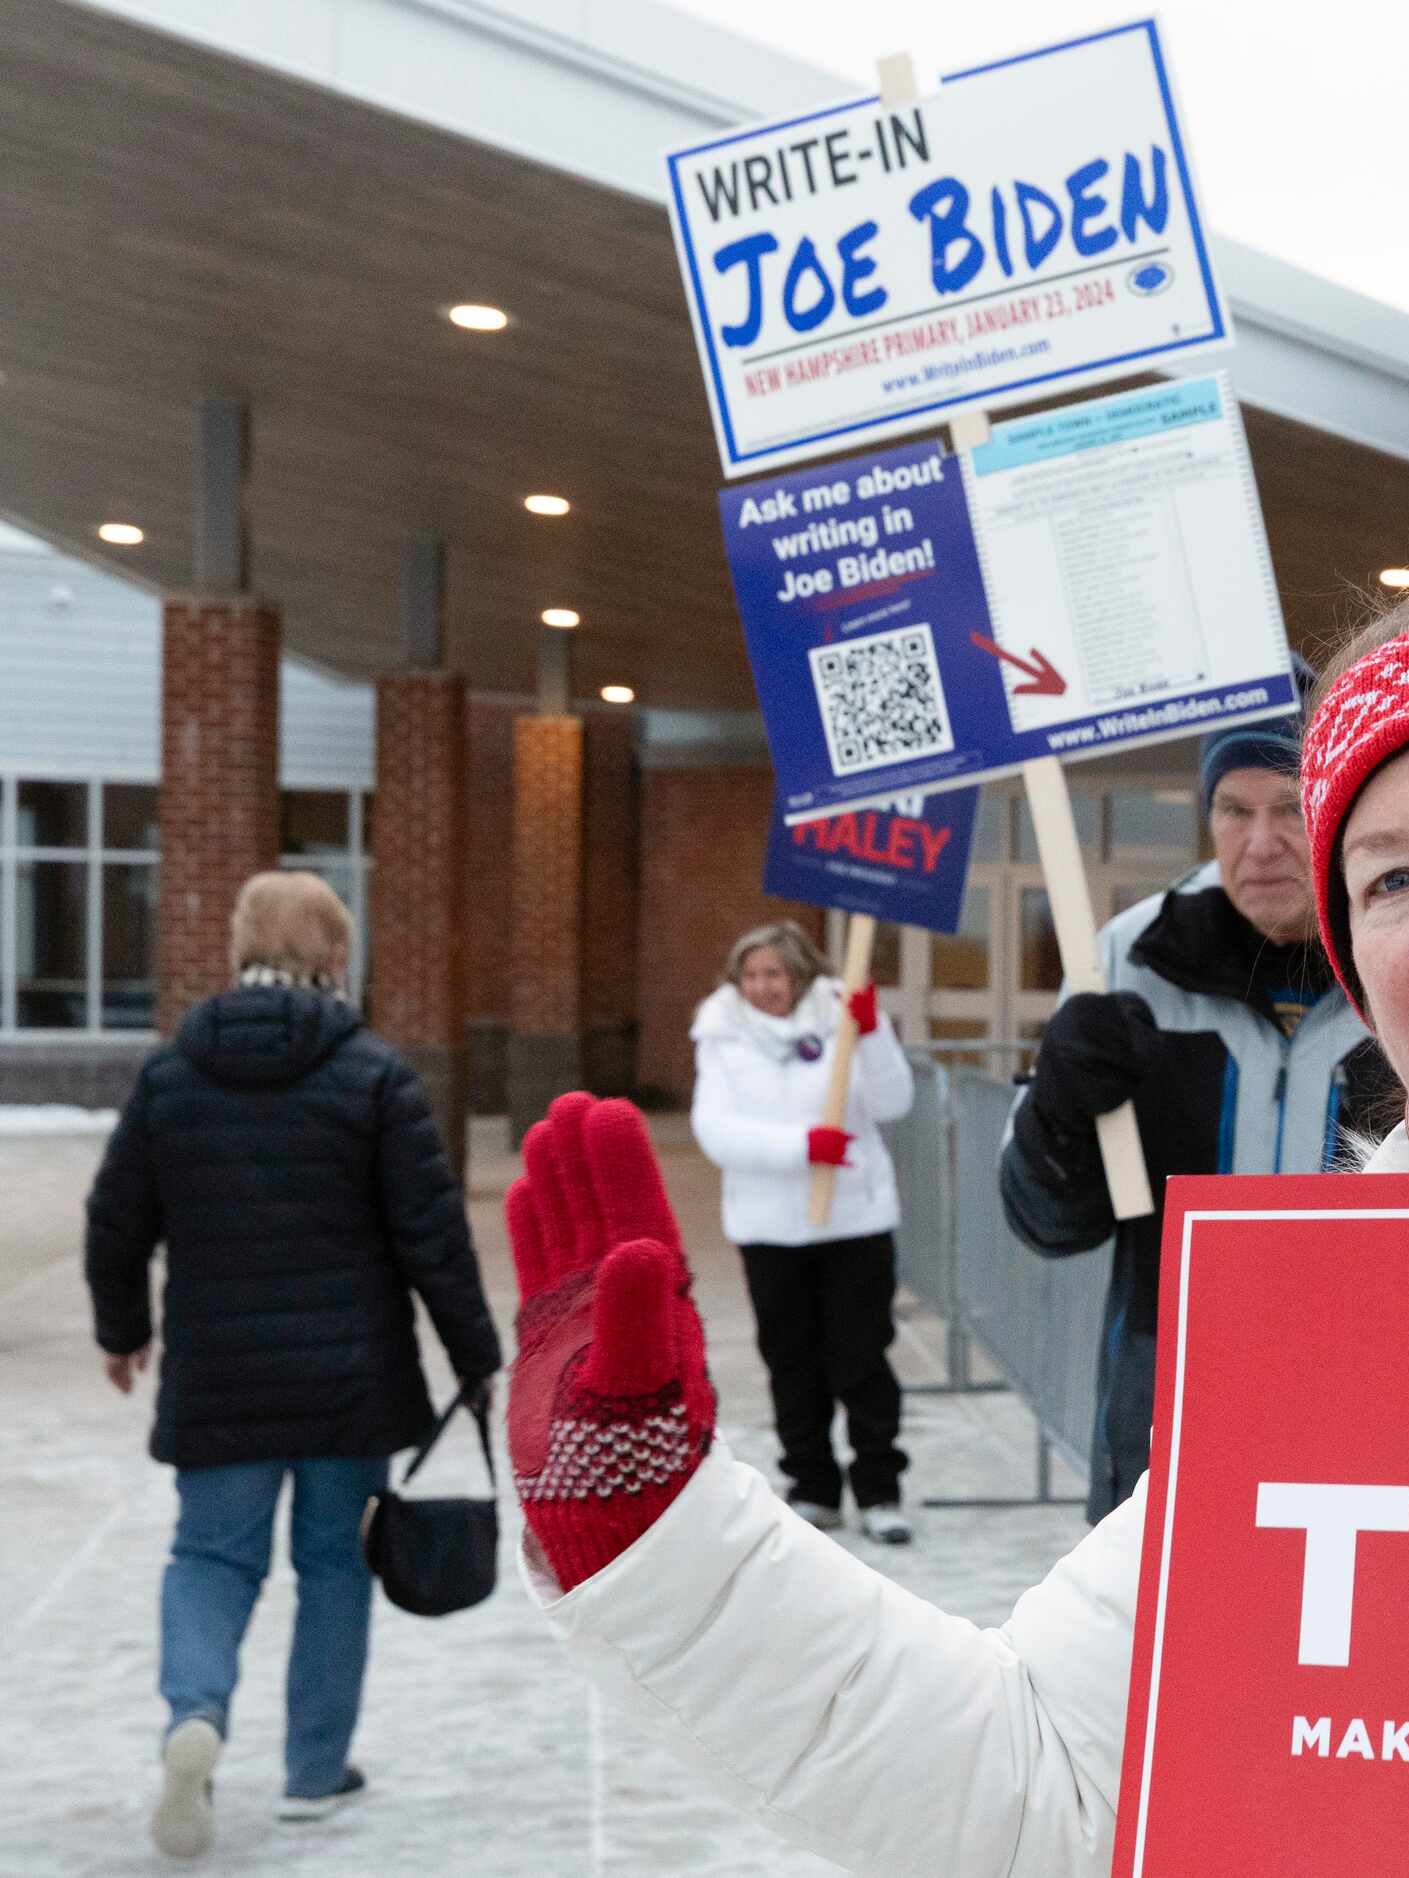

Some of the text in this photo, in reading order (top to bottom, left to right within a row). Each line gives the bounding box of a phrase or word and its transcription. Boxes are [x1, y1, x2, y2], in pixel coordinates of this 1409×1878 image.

[698, 109, 929, 222] WRITE-IN
[713, 145, 1169, 348] JOE BIDEN
[743, 277, 1116, 397] NEW HAMPSHIRE PRIMARY, JANUARY 23, 2024
[1160, 402, 1217, 424] SAMPLE
[739, 489, 798, 528] Ask
[802, 481, 850, 513] me
[856, 454, 945, 499] about
[772, 504, 915, 561] writing in
[777, 537, 936, 602] Joe Biden!
[792, 809, 950, 873] HALEY
